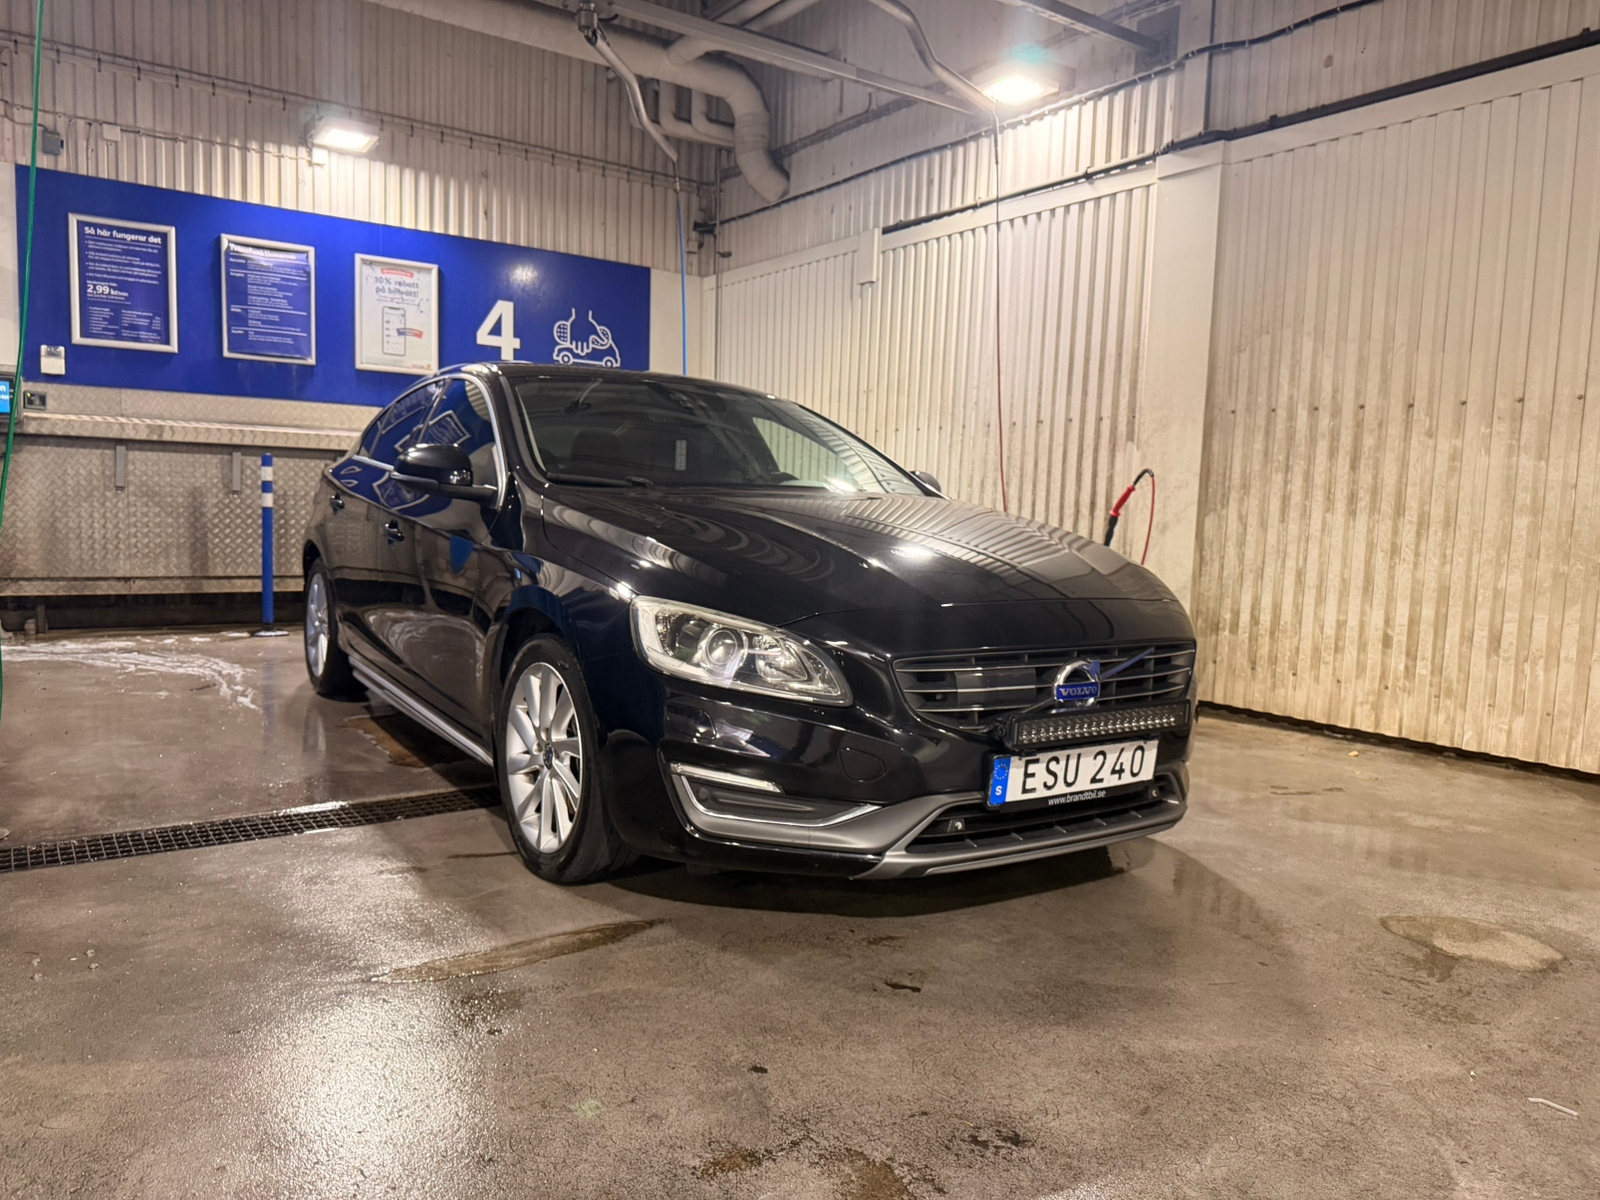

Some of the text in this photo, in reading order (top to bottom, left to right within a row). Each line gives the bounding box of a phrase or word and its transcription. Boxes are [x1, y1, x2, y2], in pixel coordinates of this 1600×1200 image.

[84, 226, 161, 244] Så här fungerar det
[86, 284, 109, 295] 2,99
[376, 285, 386, 294] på
[395, 280, 419, 289] rabatt
[477, 300, 521, 361] 4
[1059, 686, 1098, 697] VOLVO
[1021, 745, 1145, 795] ESU 240
[995, 785, 1002, 796] S
[1048, 789, 1106, 806] www.brandtbil.se
